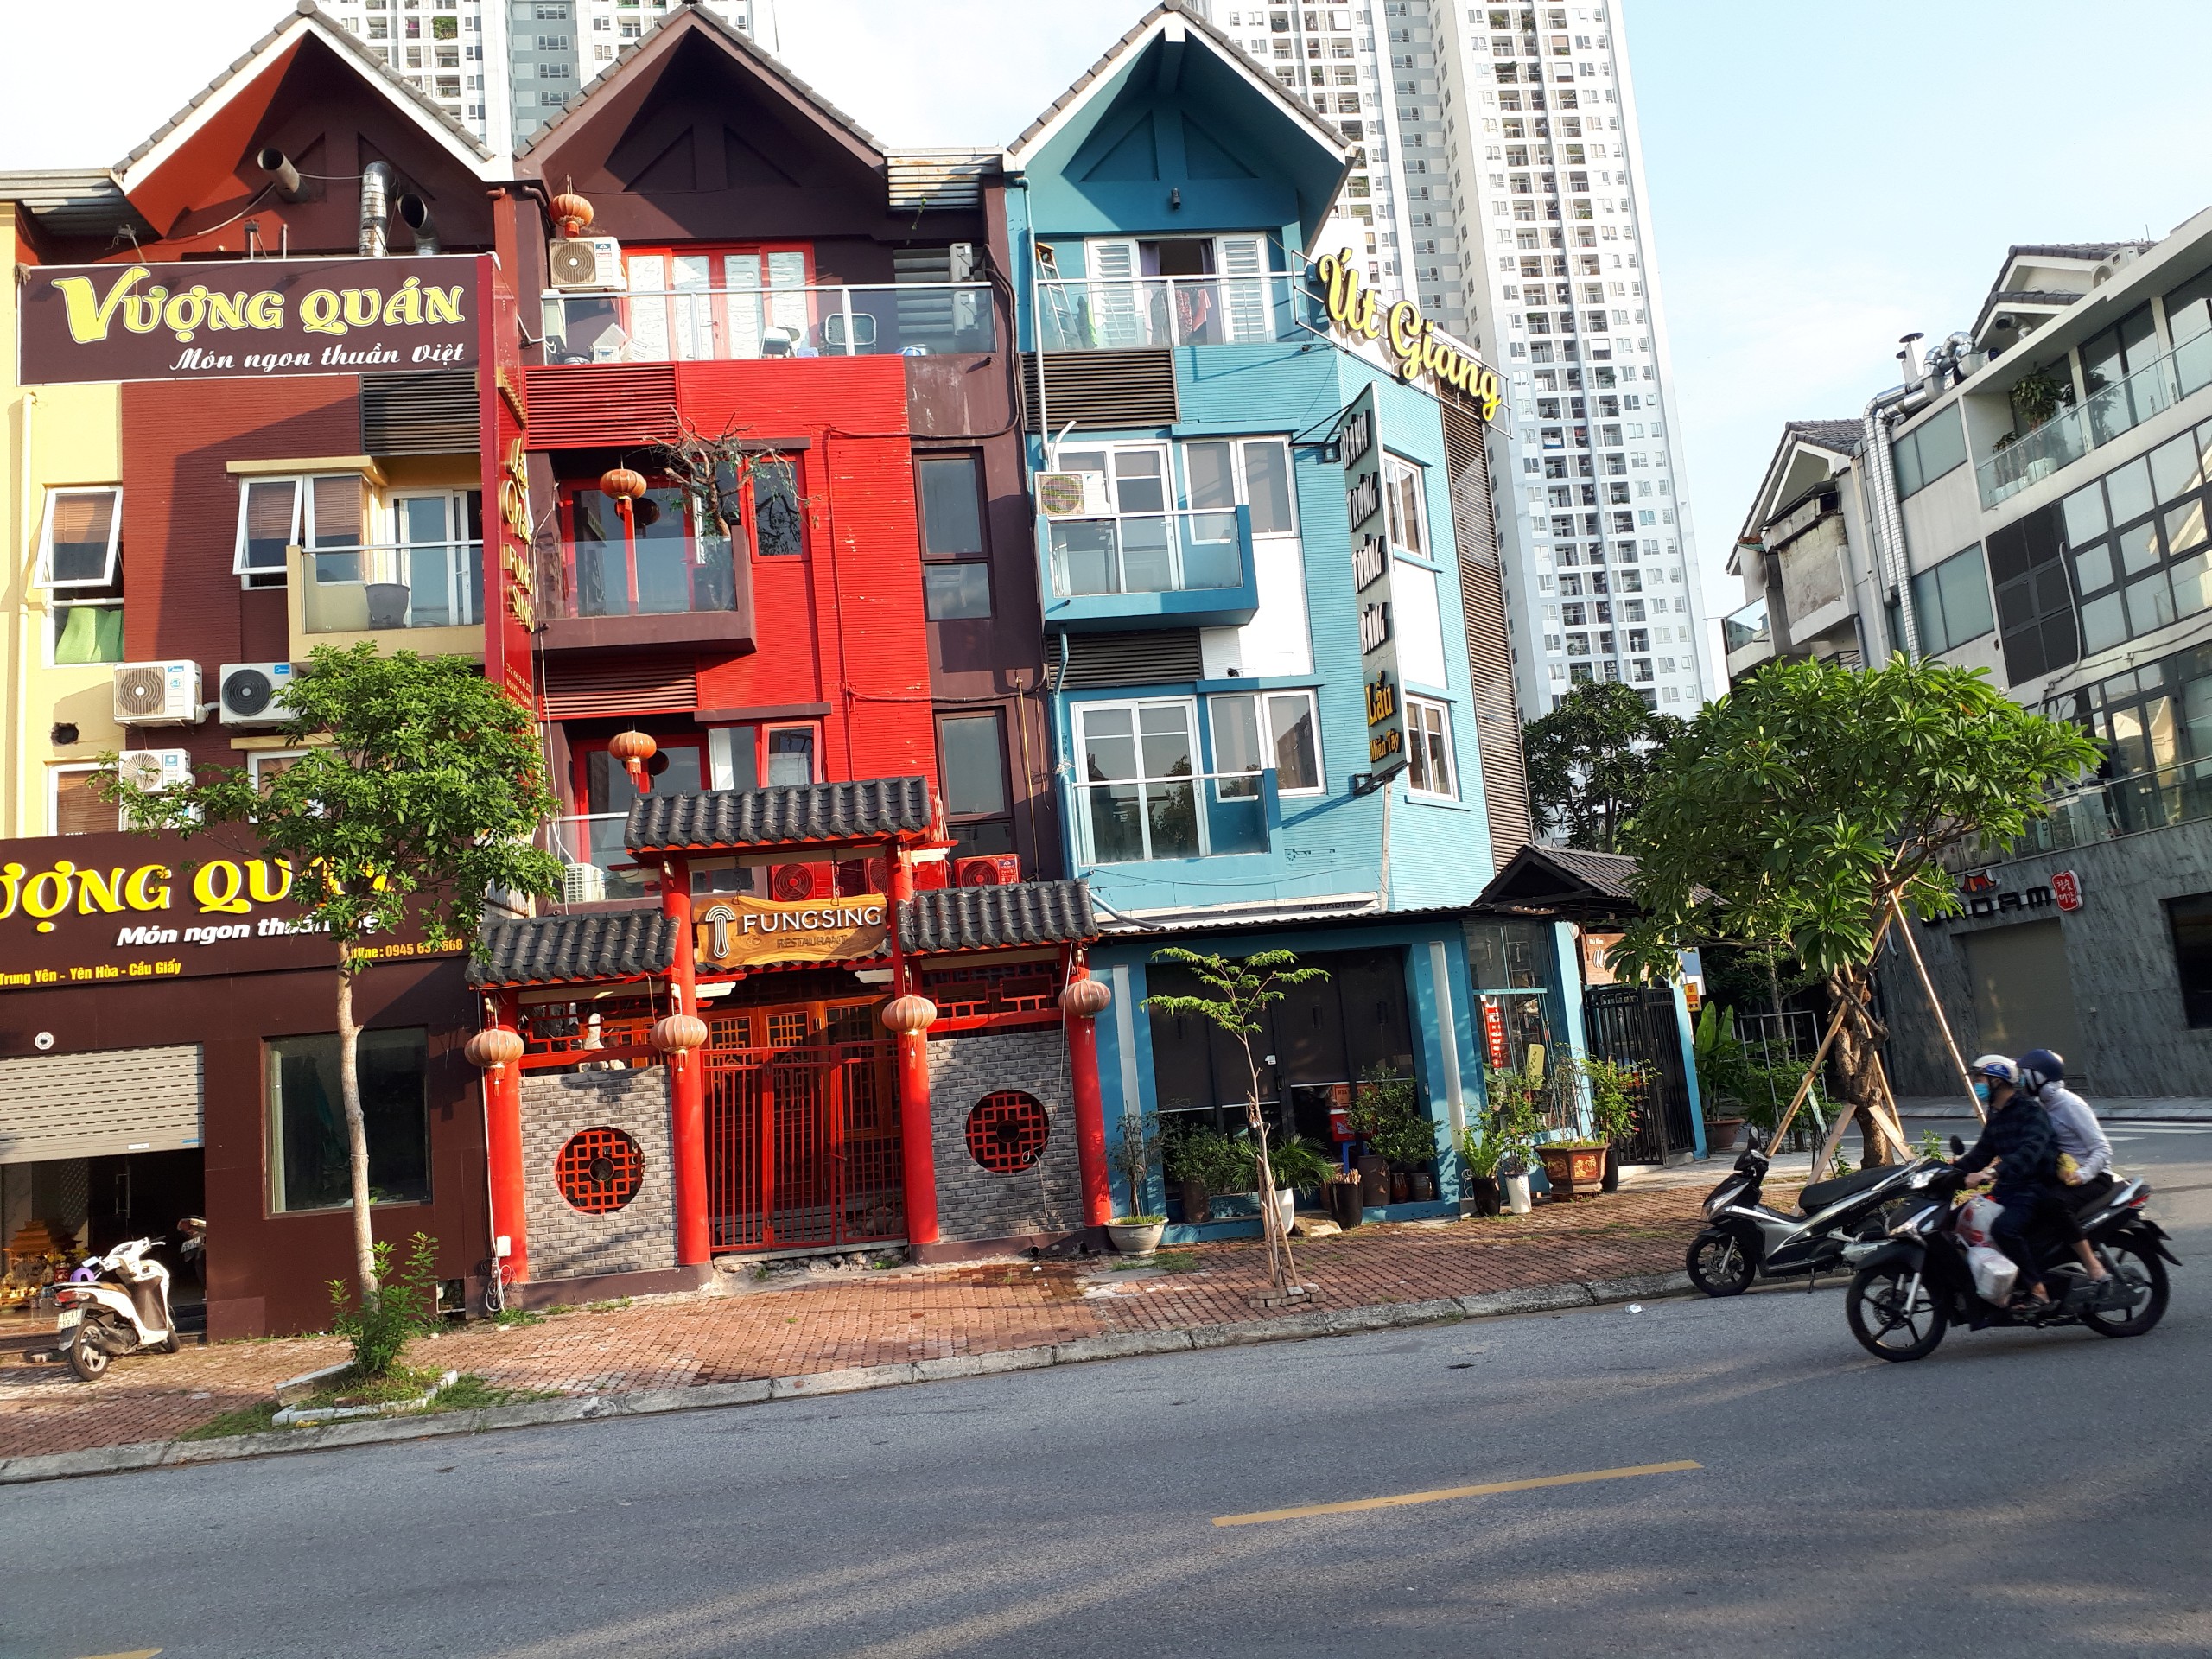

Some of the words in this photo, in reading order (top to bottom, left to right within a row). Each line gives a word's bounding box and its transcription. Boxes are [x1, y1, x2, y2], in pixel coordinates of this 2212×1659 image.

[50, 267, 285, 343] VƯỢNG
[299, 276, 466, 335] QUÁN
[169, 347, 235, 370] Món
[244, 352, 312, 372] ngon
[321, 343, 400, 365] thuần
[1317, 247, 1380, 340] Út
[1388, 300, 1502, 422] Giang
[1342, 409, 1370, 470] BÁNH
[1346, 472, 1379, 532] TRÁNG
[504, 543, 533, 594] FUNG
[507, 585, 535, 632] SING
[1361, 602, 1388, 655] BÀNG
[1365, 671, 1395, 727] Lẩu
[117, 925, 177, 946] Món
[184, 923, 250, 944] ngon
[743, 906, 882, 933] FUNGSING
[776, 934, 849, 949] RESTAURANT
[35, 969, 57, 982] Yên
[69, 967, 92, 981] Yên
[95, 964, 118, 979] Hòa
[156, 957, 181, 975] Giấy
[385, 944, 414, 957] 0945
